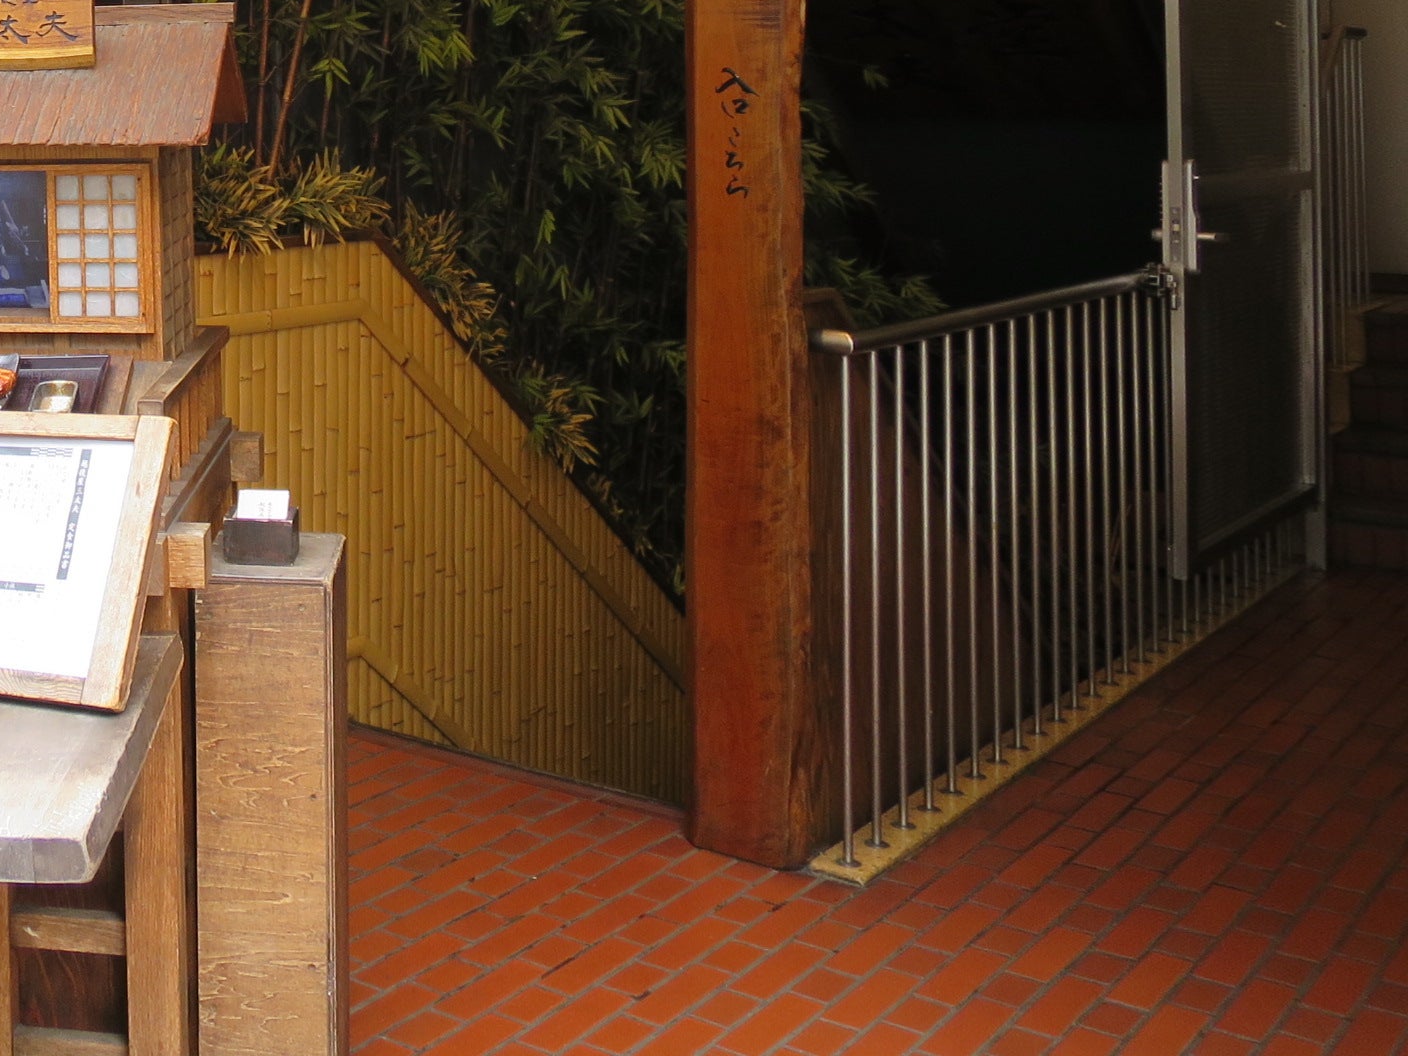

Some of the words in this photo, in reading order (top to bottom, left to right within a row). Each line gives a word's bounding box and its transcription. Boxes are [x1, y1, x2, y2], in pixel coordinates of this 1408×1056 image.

[714, 66, 760, 199] 入口こちら
